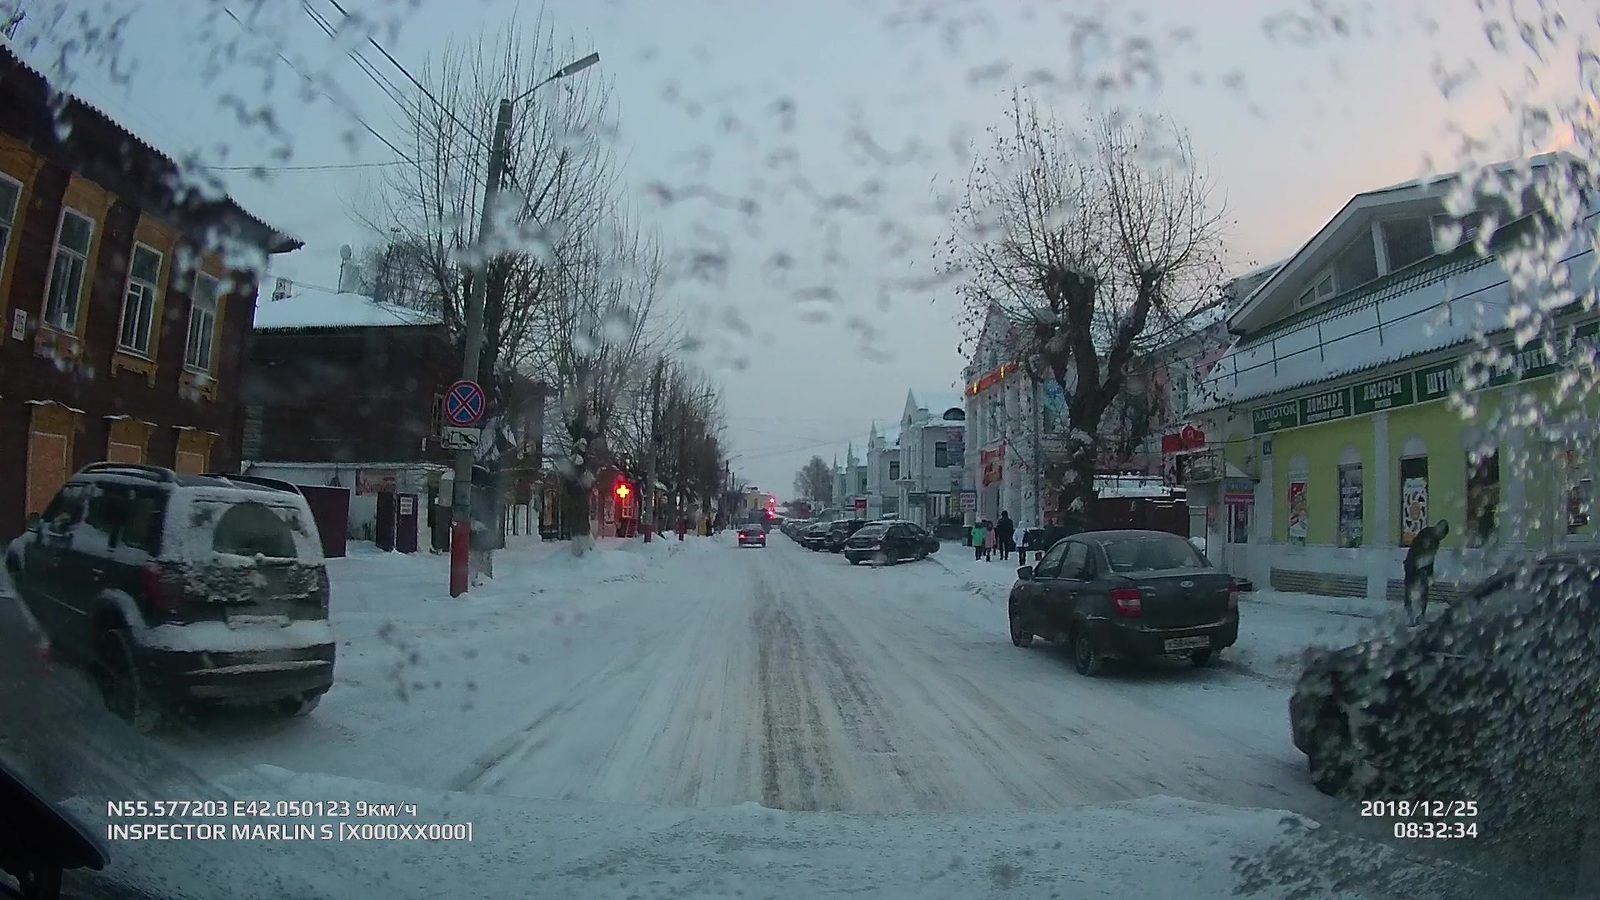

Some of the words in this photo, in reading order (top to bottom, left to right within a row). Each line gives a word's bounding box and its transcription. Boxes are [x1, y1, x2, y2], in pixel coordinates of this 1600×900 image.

[1363, 376, 1402, 401] ЛЮСТРЫ
[1426, 362, 1472, 395] ШТОР
[1254, 403, 1297, 423] ЛАПОТОК
[1306, 391, 1344, 414] ЛОМБАРД
